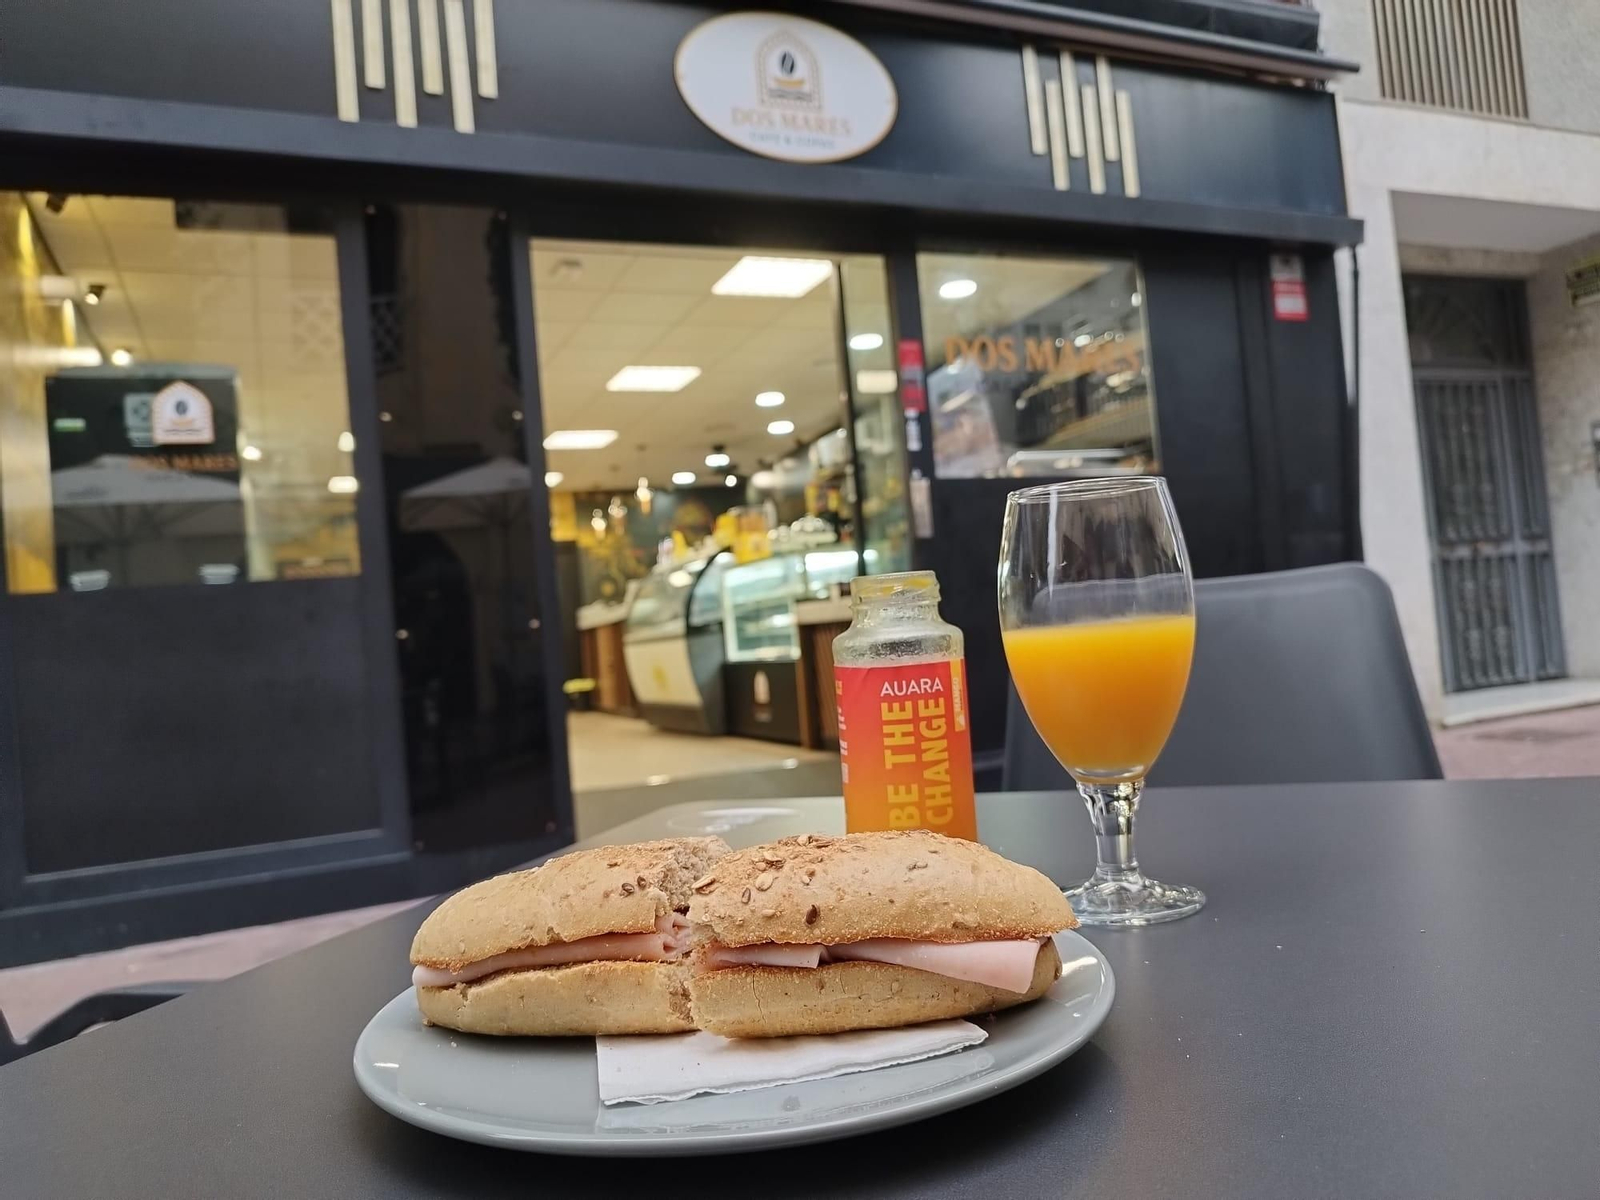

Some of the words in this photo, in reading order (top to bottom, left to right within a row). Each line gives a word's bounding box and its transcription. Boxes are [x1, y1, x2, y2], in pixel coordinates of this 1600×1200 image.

[731, 107, 775, 130] DOS
[779, 110, 852, 137] MARES
[943, 335, 1018, 373] DOS
[880, 677, 943, 697] AUARA
[880, 700, 916, 770] THE
[918, 697, 954, 826] CHANGE
[887, 783, 921, 828] BE
